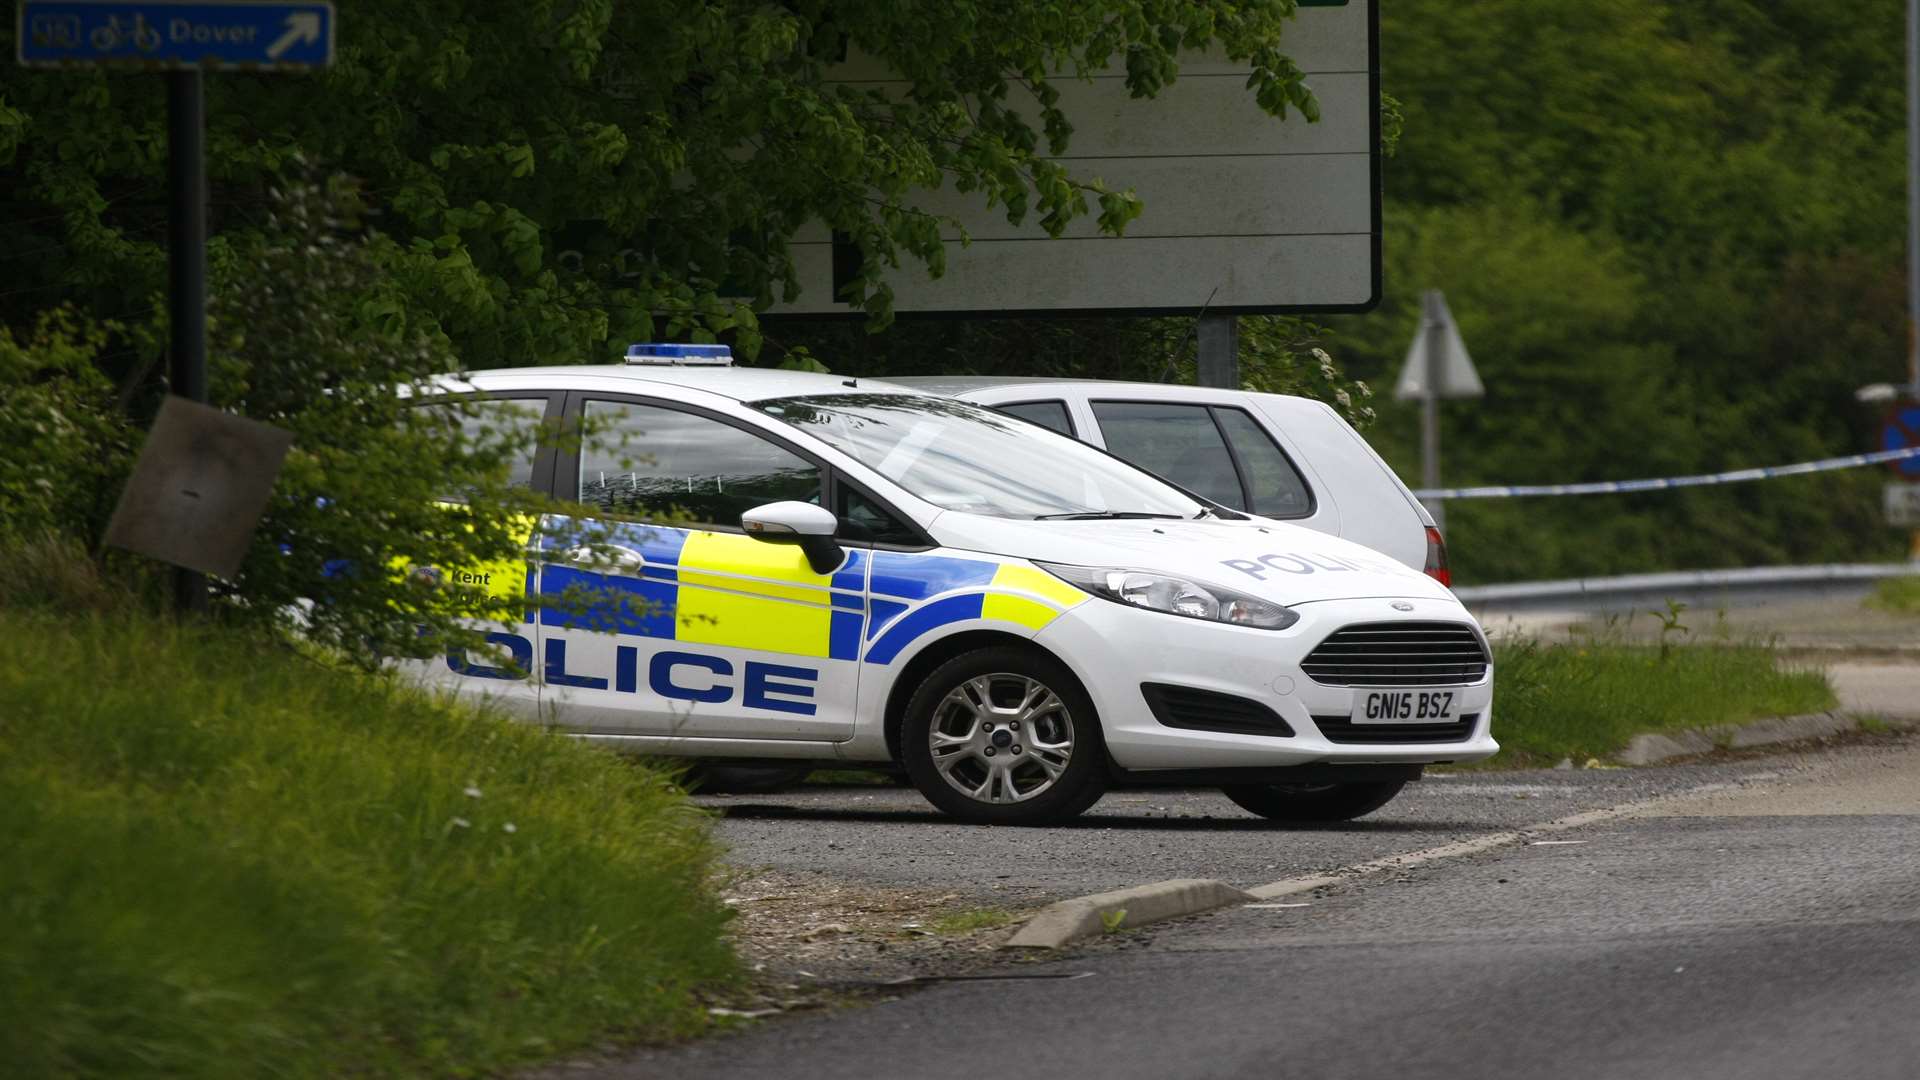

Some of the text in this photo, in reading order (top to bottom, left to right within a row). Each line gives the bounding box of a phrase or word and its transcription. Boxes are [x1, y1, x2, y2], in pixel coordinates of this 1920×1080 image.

[168, 17, 257, 45] Dover
[452, 570, 491, 585] Kent
[1219, 552, 1396, 581] POLI
[417, 620, 818, 716] OLICE
[1366, 692, 1453, 719] GN15 BSZ
